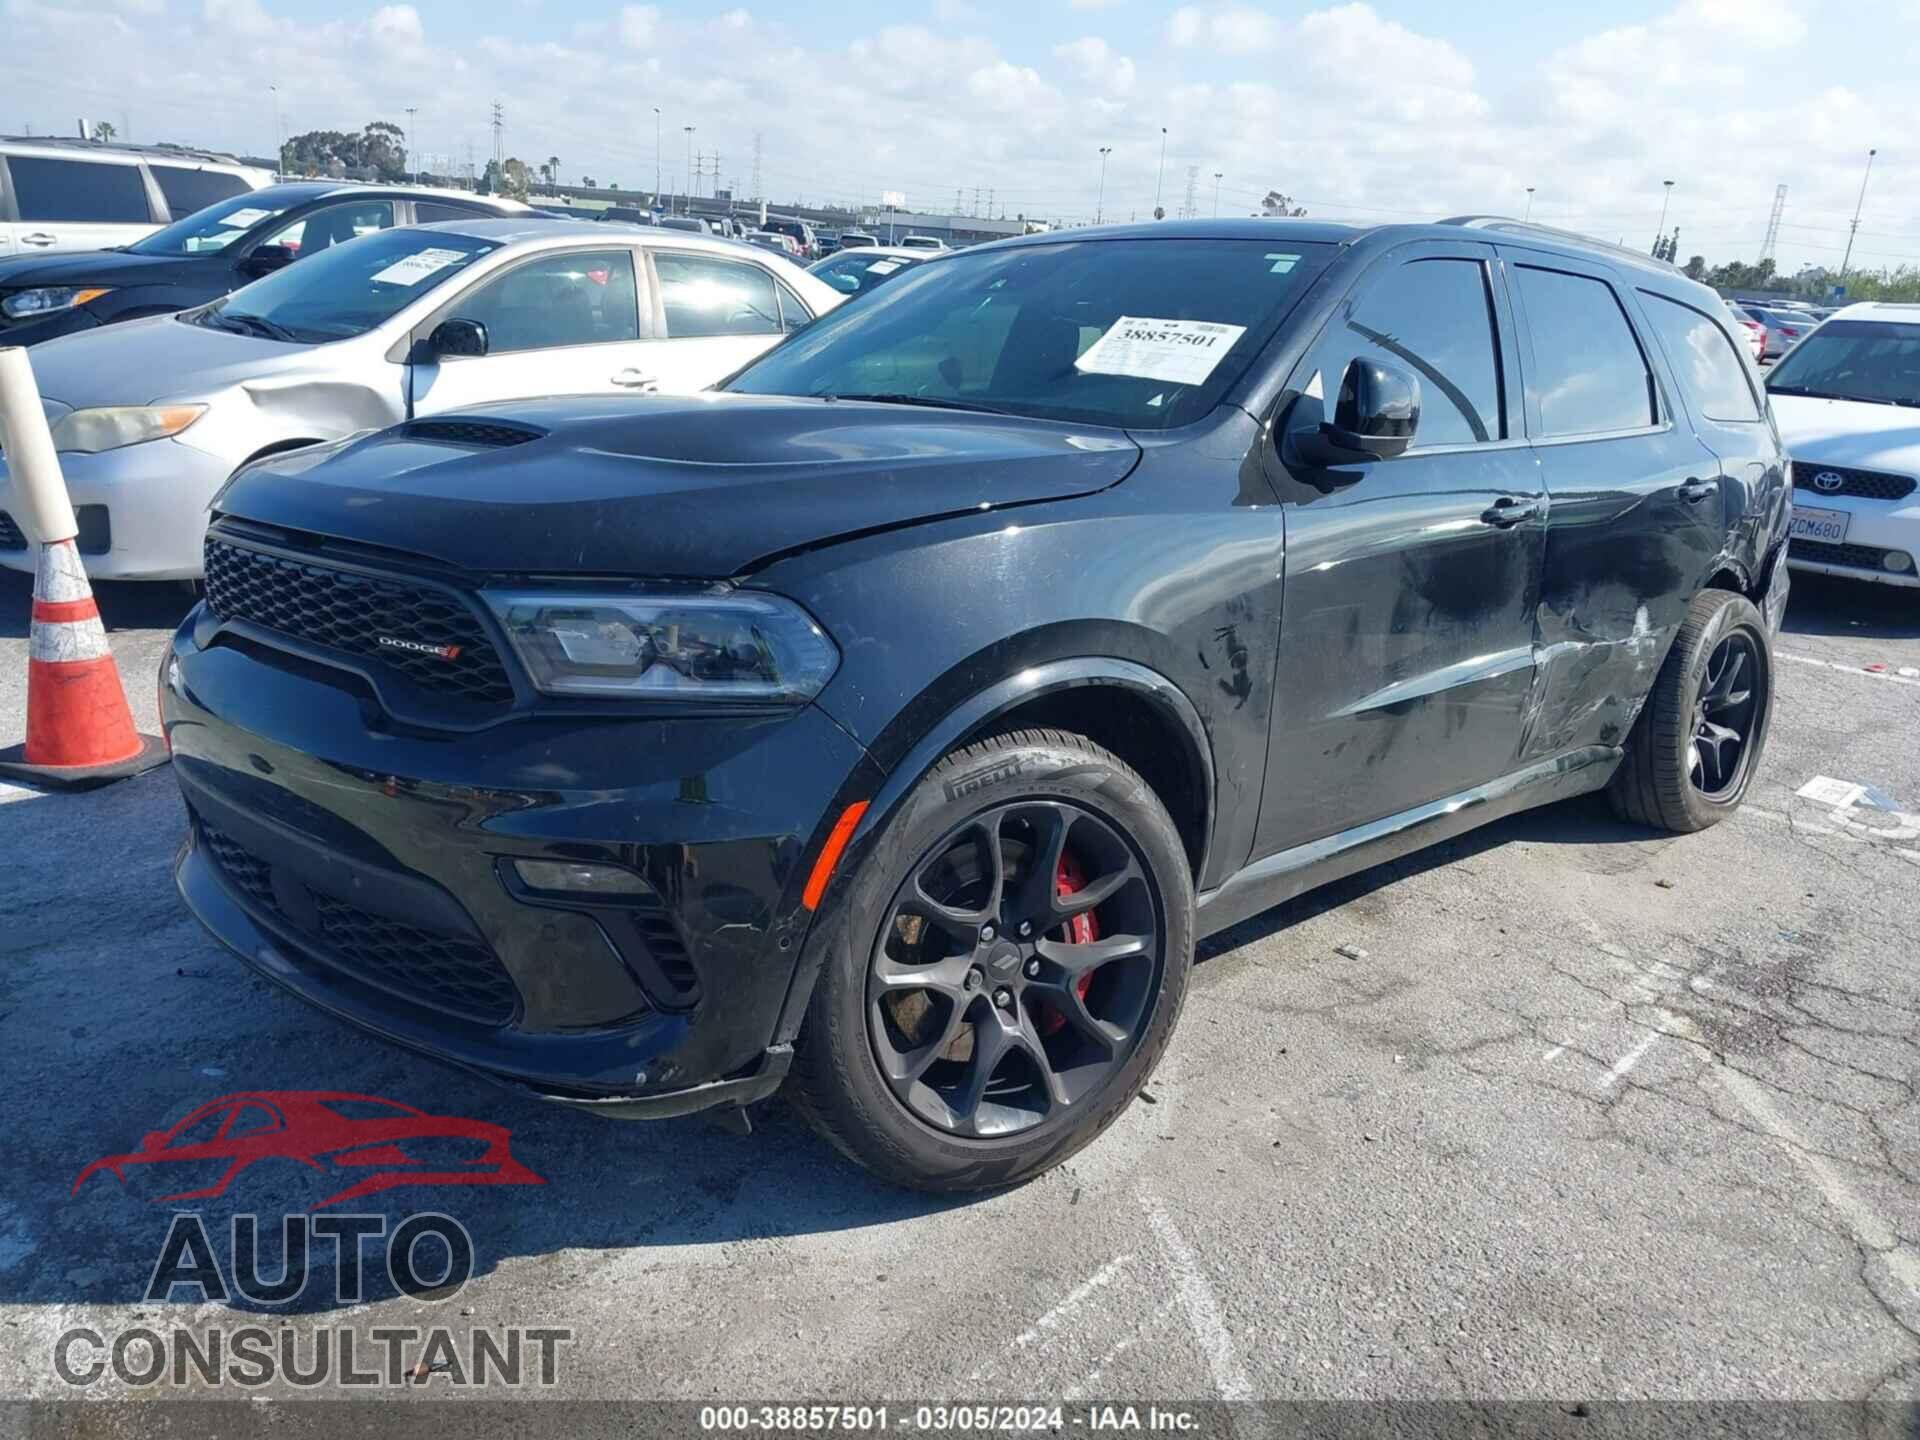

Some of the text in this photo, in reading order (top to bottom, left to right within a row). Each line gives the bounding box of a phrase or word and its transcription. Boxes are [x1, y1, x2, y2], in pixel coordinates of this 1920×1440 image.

[1116, 329, 1217, 348] 38857501
[379, 636, 449, 657] DODGE
[943, 755, 1023, 802] PIRELLI
